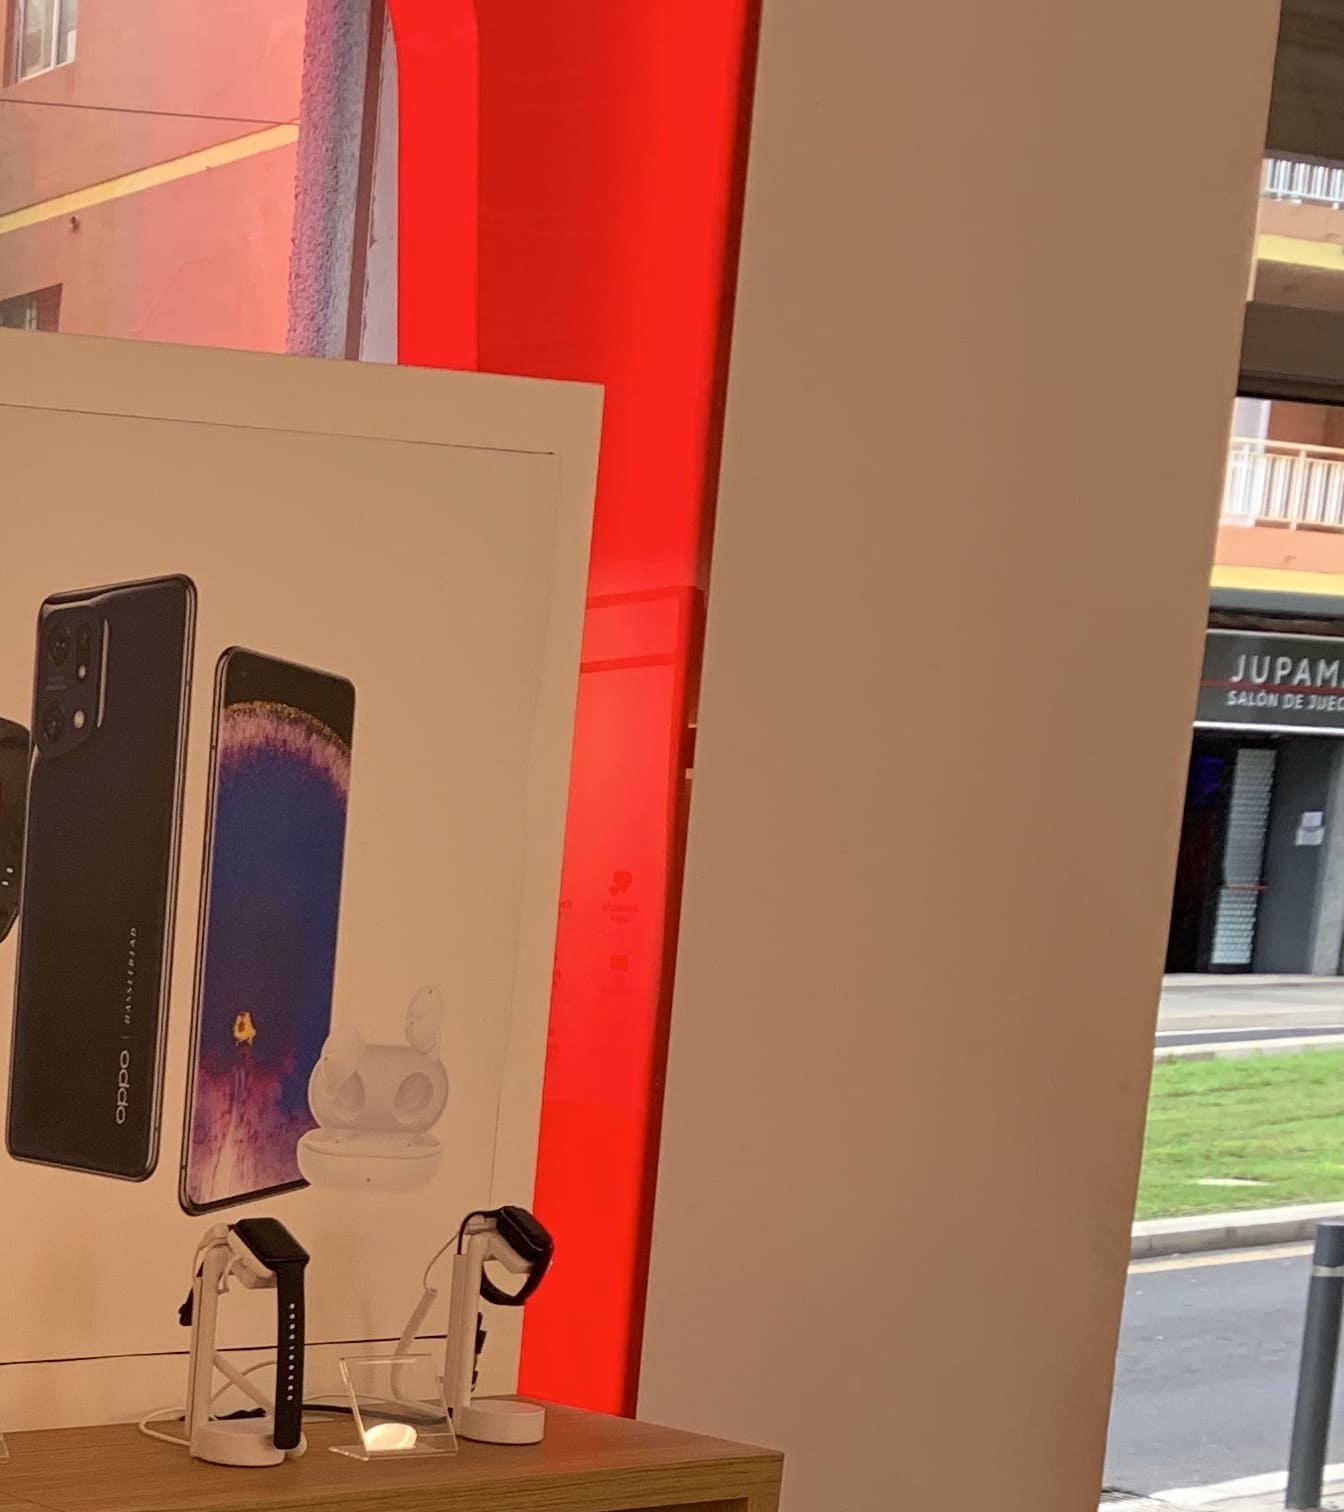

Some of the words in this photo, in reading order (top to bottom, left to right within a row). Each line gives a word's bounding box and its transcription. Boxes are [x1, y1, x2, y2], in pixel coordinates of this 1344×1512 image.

[1229, 654, 1344, 688] JUPAM
[1226, 689, 1279, 709] SALÓN
[1281, 693, 1305, 710] DE
